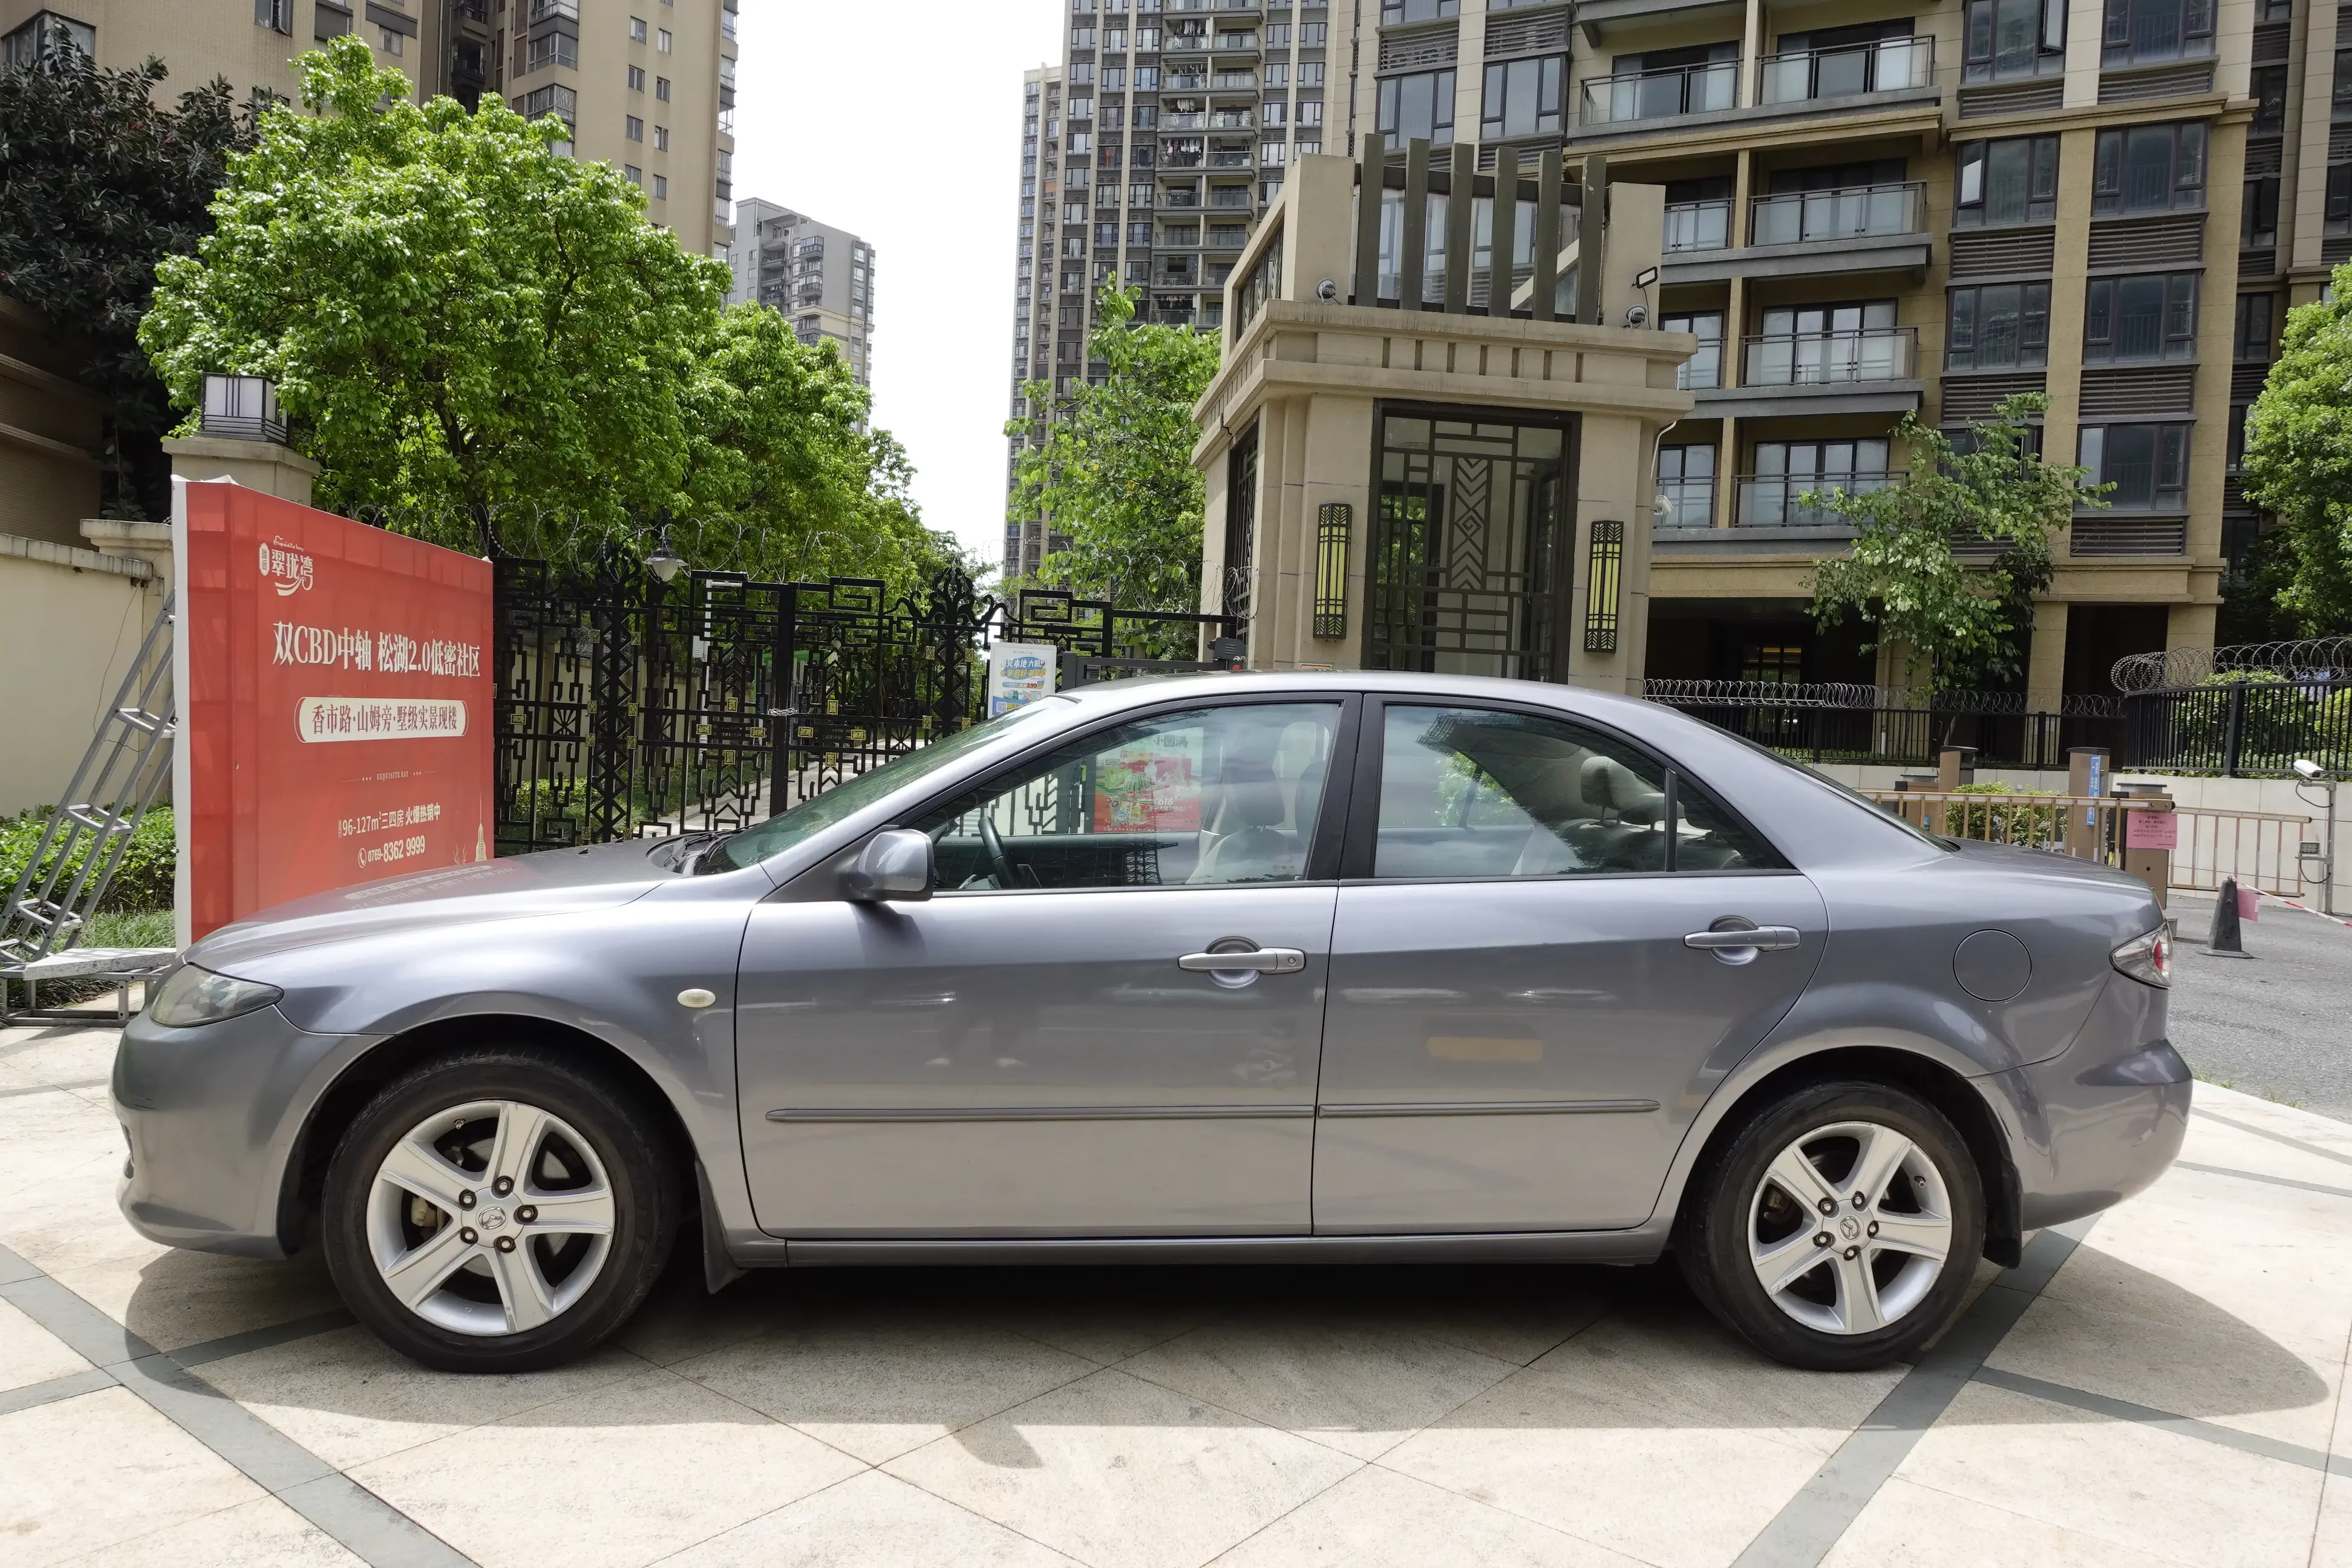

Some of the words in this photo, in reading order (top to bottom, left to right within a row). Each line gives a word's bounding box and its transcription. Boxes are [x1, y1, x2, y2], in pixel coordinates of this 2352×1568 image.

[271, 549, 313, 590] 翠珑湾
[272, 621, 372, 671] 双CBD中轴
[377, 632, 480, 678] 松湖2.0低密社区
[376, 771, 400, 781] EXQUISITE
[405, 802, 440, 825] 火爆热销中
[368, 839, 404, 862] 0769-8362
[406, 835, 426, 857] 9999
